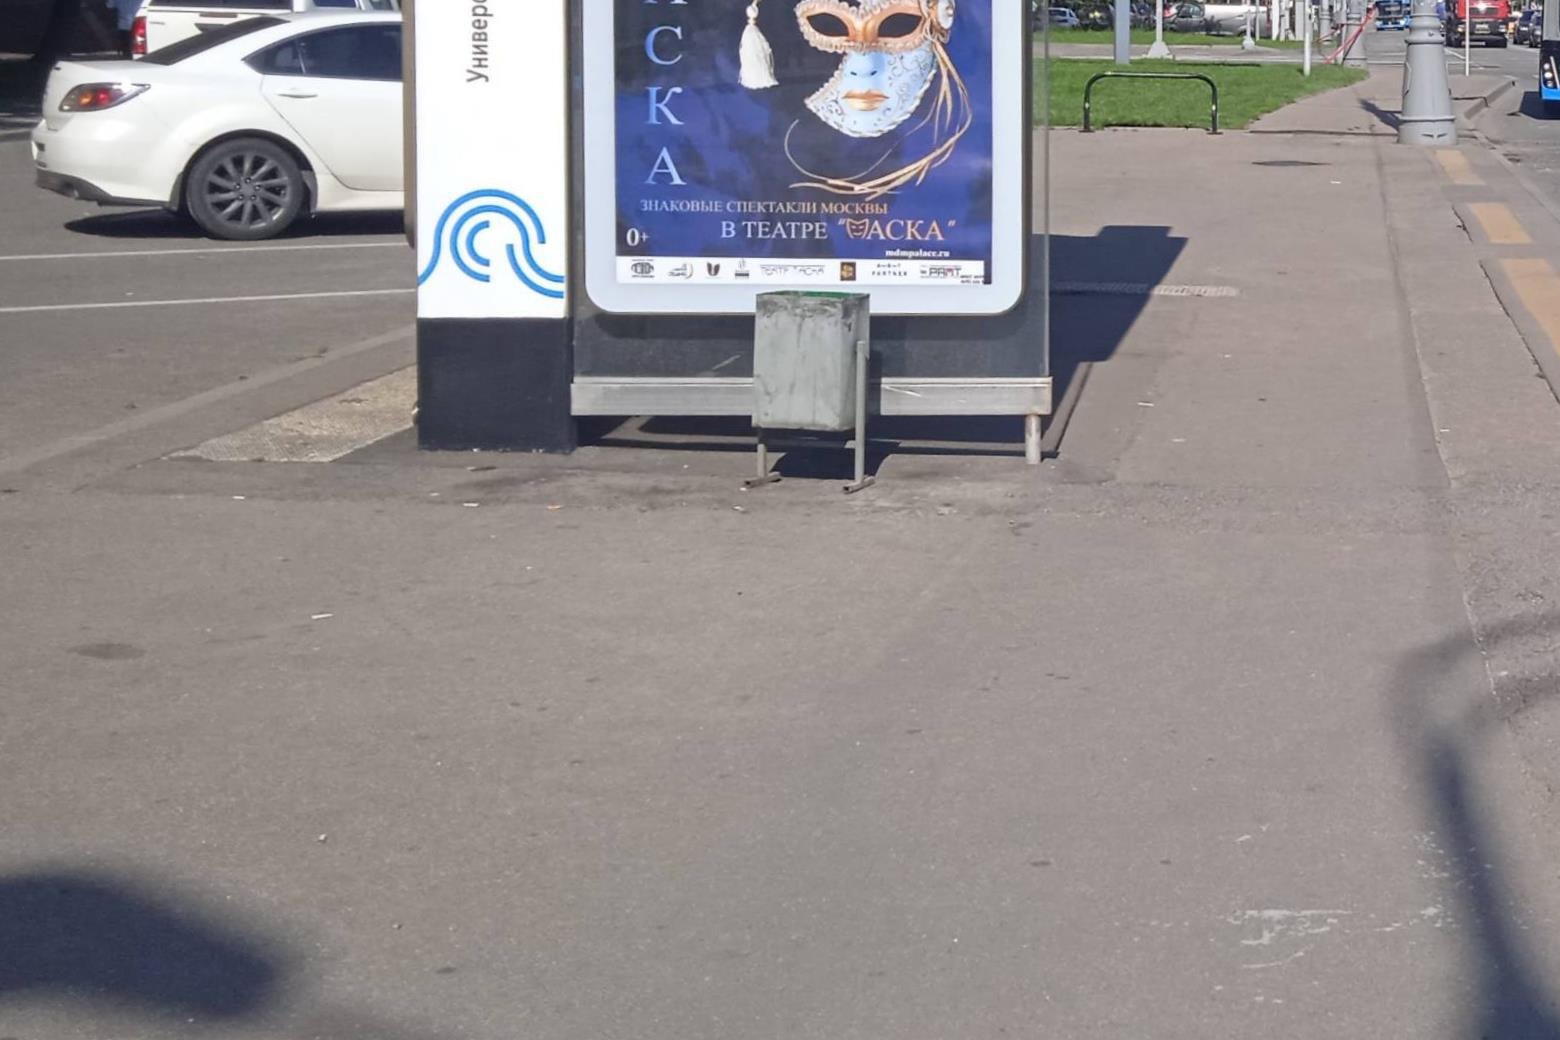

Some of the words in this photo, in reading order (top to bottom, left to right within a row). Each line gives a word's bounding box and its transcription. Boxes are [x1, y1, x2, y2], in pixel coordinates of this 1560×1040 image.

[640, 199, 723, 214] ЗНАКОВЫЕ
[726, 200, 816, 215] СПЕКТАКЛИ
[818, 201, 888, 216] МОСКВЫ
[625, 227, 651, 247] 0+
[721, 220, 736, 239] В
[741, 221, 828, 240] ТЕАТРЕ
[885, 248, 950, 259] mdmpalace.ru
